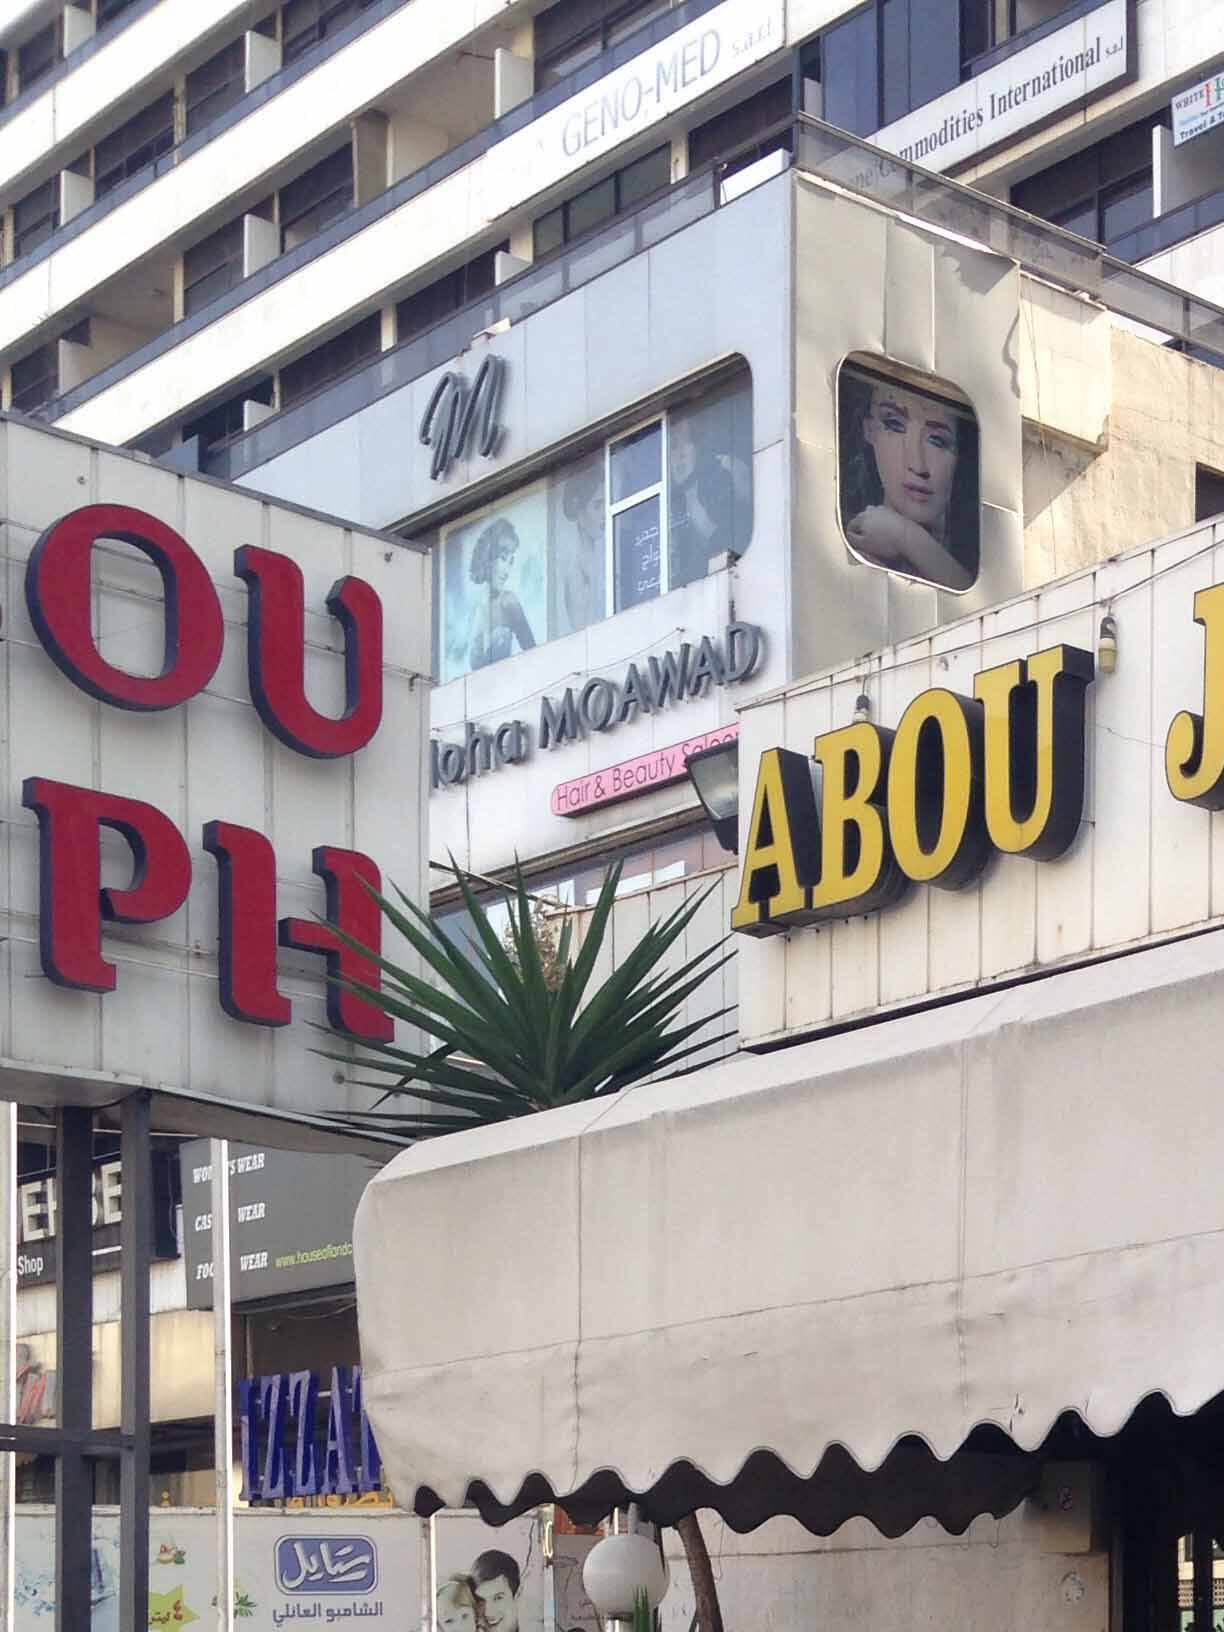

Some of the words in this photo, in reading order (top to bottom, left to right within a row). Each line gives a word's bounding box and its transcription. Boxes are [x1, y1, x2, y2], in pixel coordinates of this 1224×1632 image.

[562, 29, 721, 157] GENO-MED
[989, 36, 1102, 120] International
[1179, 119, 1208, 140] Travel
[25, 503, 384, 760] OU
[538, 621, 764, 750] MOAWAD
[556, 783, 590, 810] Hair
[594, 775, 607, 799] &
[612, 751, 676, 793] Beauty
[731, 643, 1096, 940] ABOU
[22, 776, 394, 1043] PH
[237, 1153, 265, 1174] WEAR
[238, 1203, 266, 1222] WEAR
[18, 1255, 44, 1276] Shop
[240, 1252, 268, 1271] WEAR
[272, 1601, 322, 1628] العائلي
[326, 1601, 383, 1622] الشامبو
